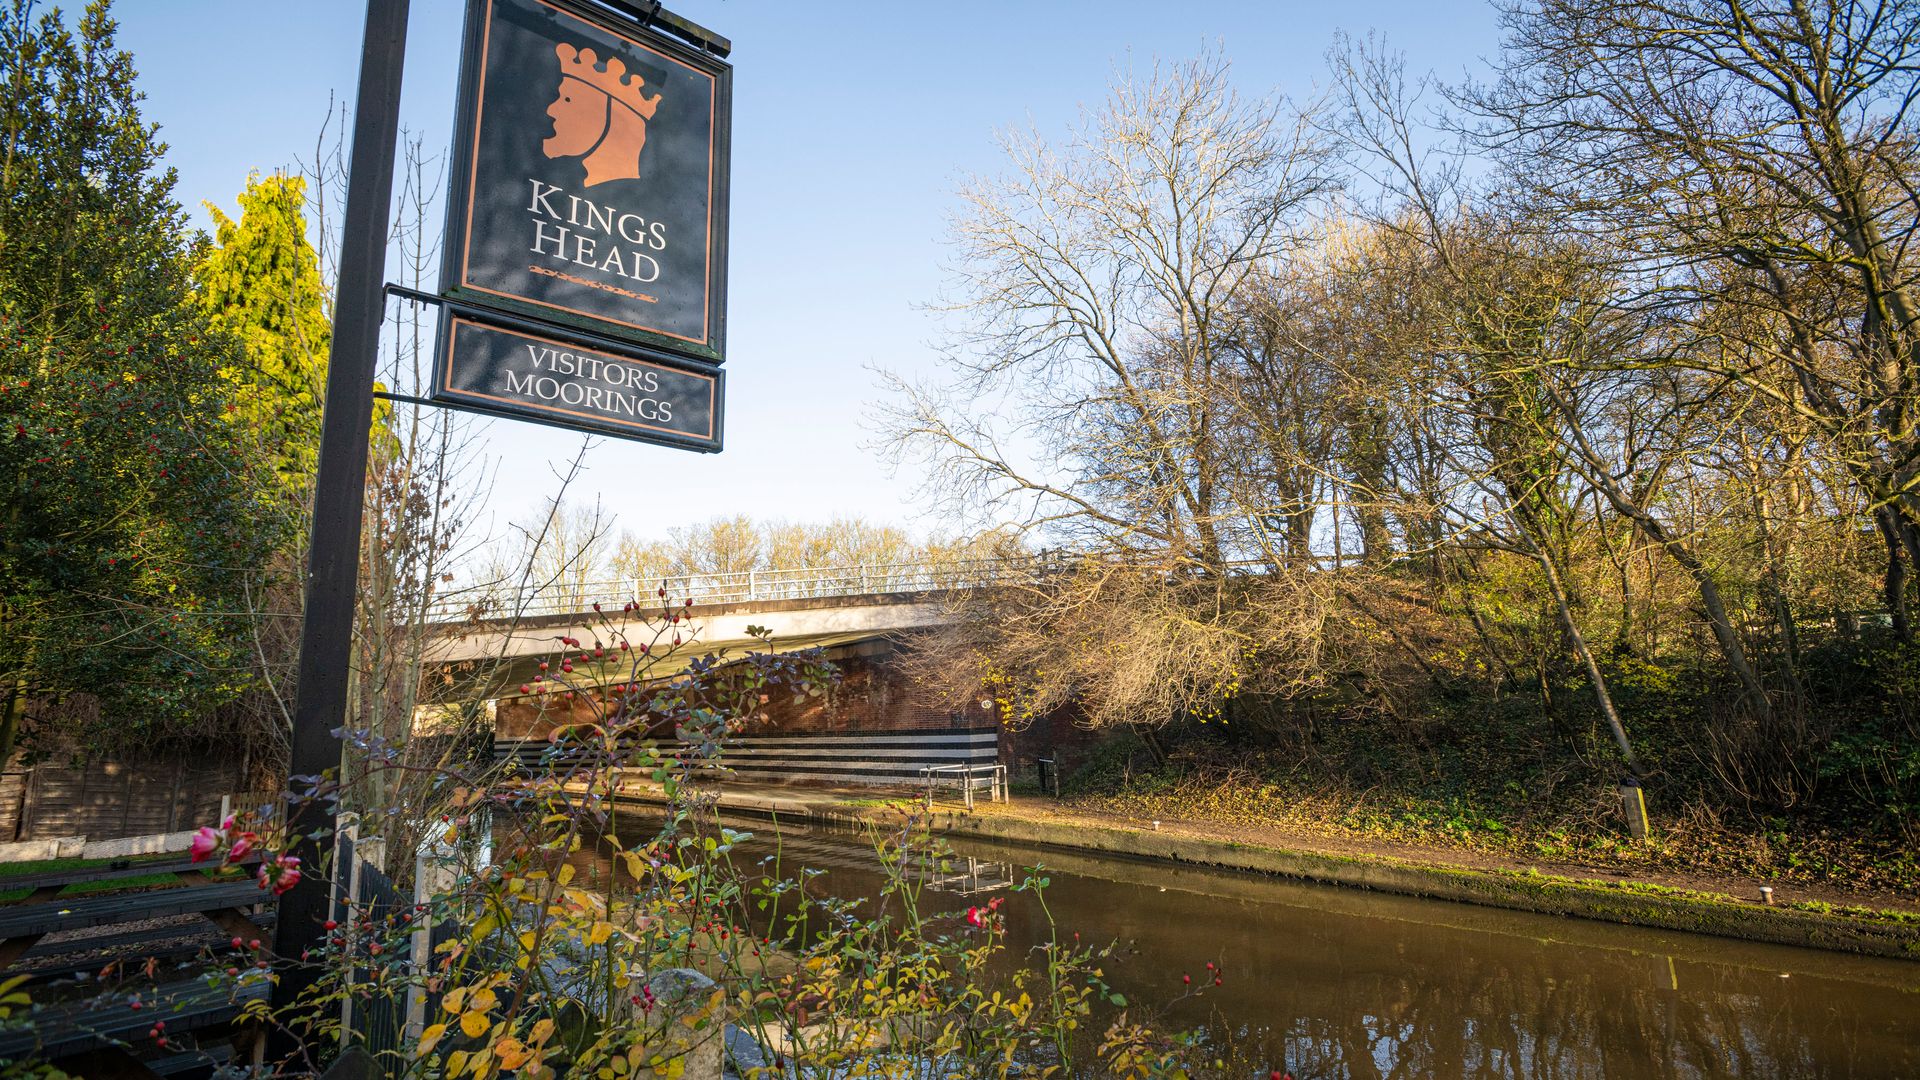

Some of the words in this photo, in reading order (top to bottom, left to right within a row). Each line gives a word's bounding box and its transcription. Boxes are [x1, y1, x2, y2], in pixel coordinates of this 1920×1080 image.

[527, 178, 667, 251] KINGS
[529, 219, 661, 283] HEAD
[504, 369, 673, 423] MOORINGS
[526, 344, 659, 393] VISITORS
